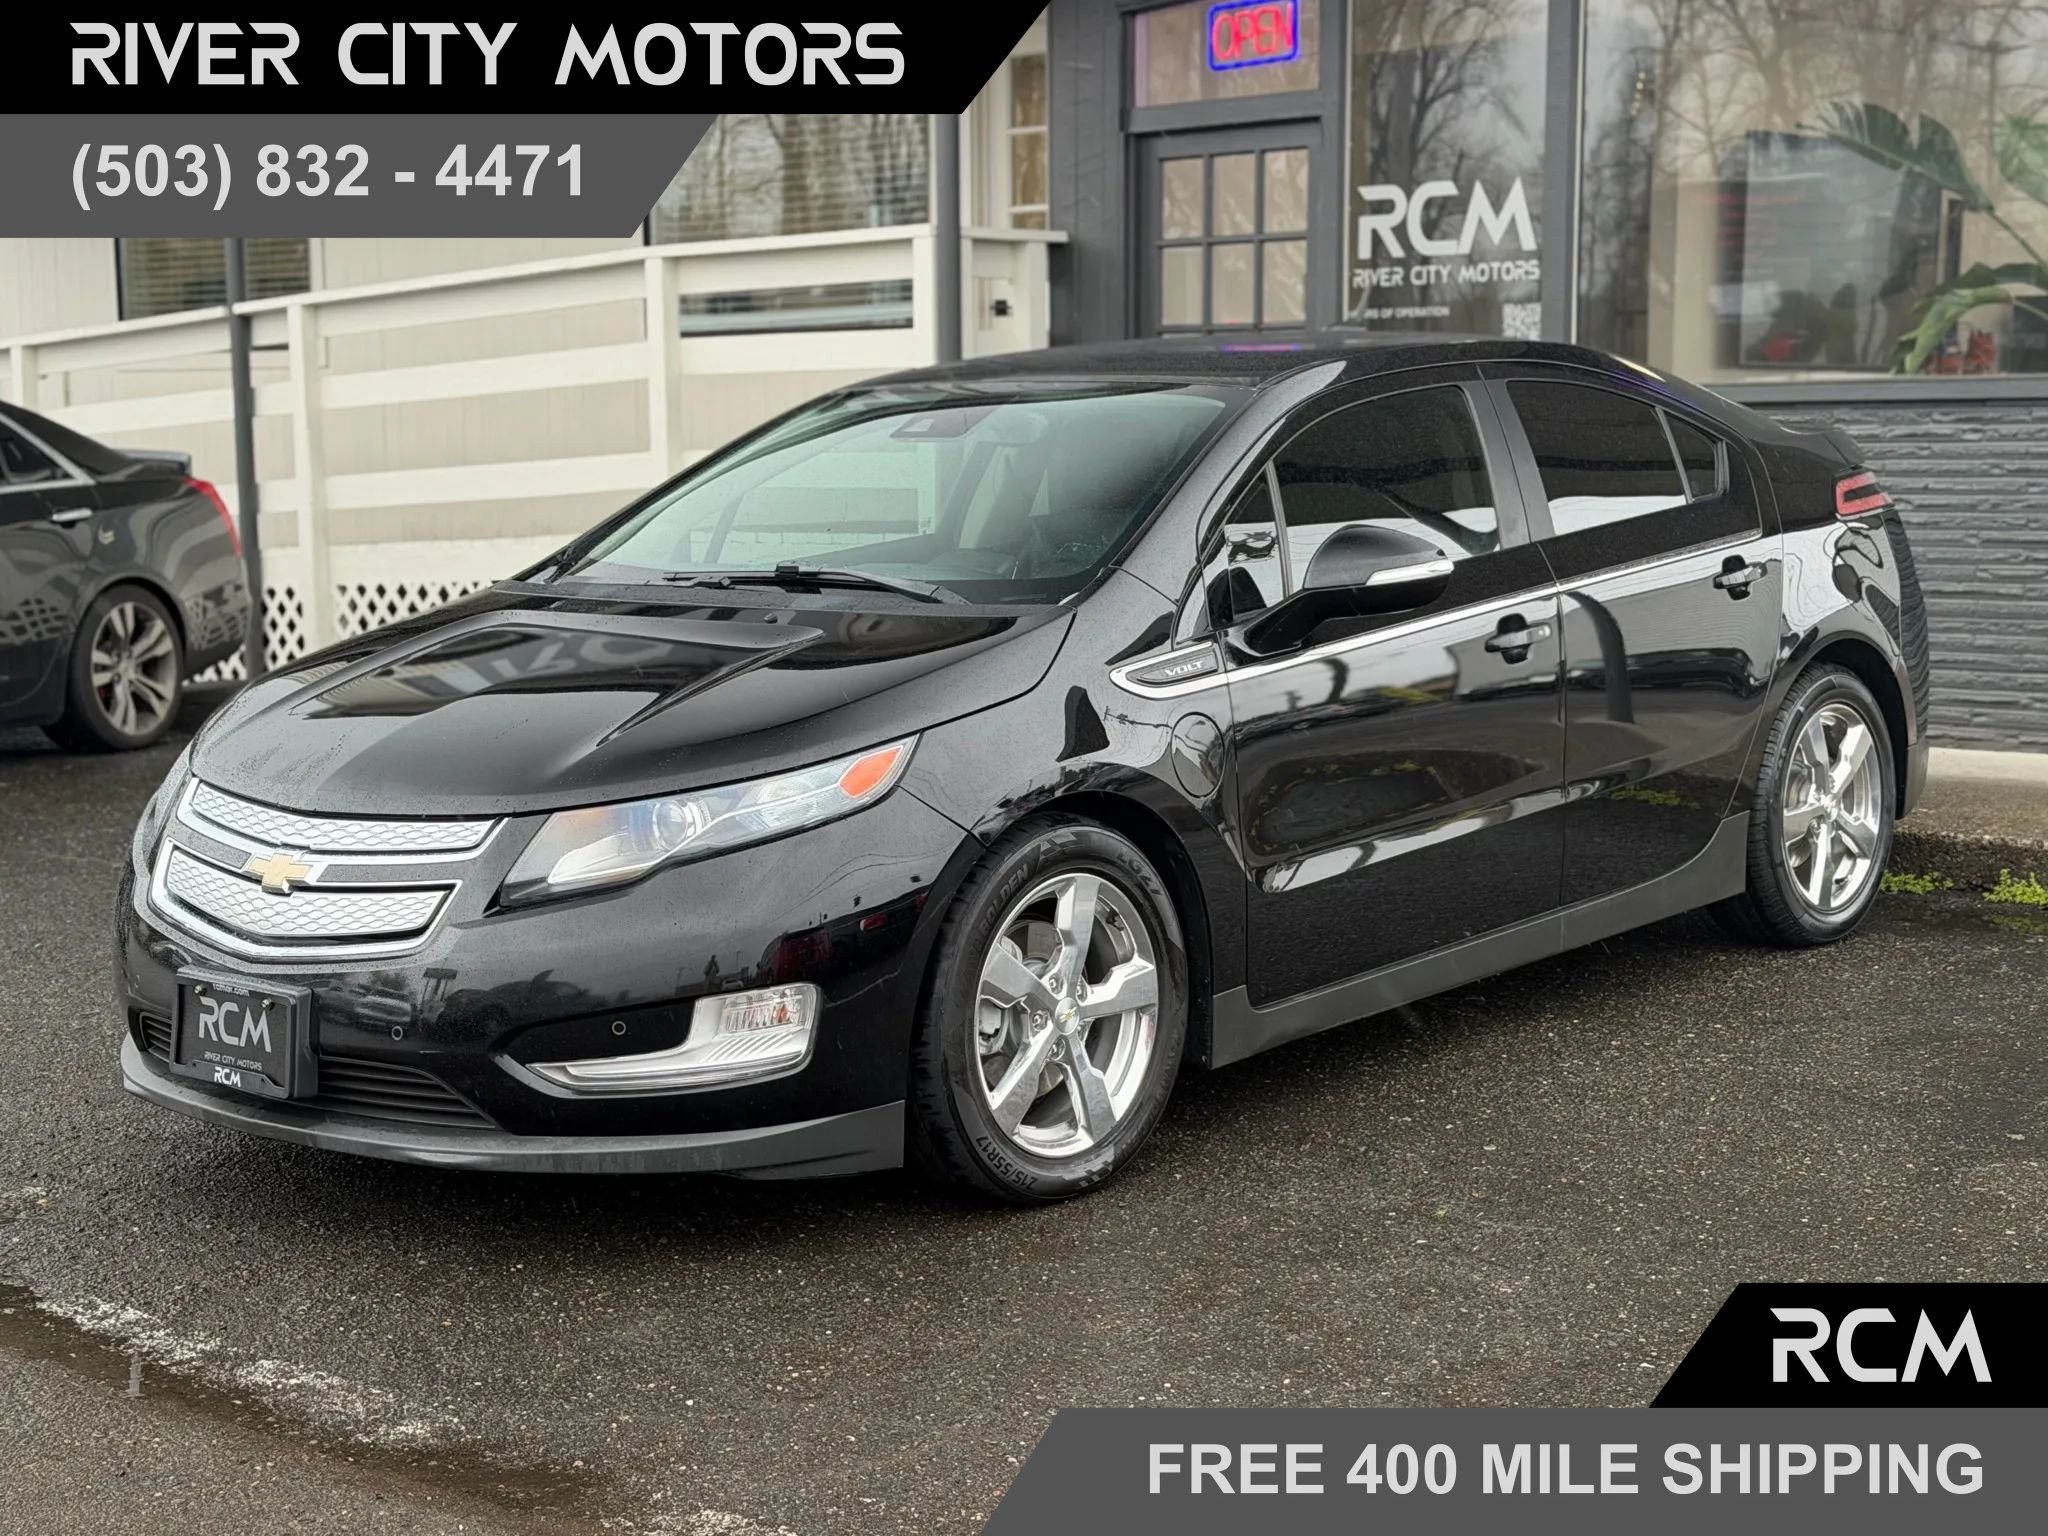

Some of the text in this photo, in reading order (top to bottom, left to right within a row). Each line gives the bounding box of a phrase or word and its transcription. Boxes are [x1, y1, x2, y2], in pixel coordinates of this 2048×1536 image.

[1212, 2, 1293, 61] OPEN
[1357, 176, 1538, 260] RCM
[1352, 260, 1540, 288] RIVER CITY MOTORS
[1165, 661, 1203, 676] VOLT
[199, 996, 272, 1053] RCM
[204, 1050, 263, 1071] RIVER CITY MOTORS
[214, 1065, 241, 1088] RCM
[976, 1136, 1038, 1190] 215/55R17
